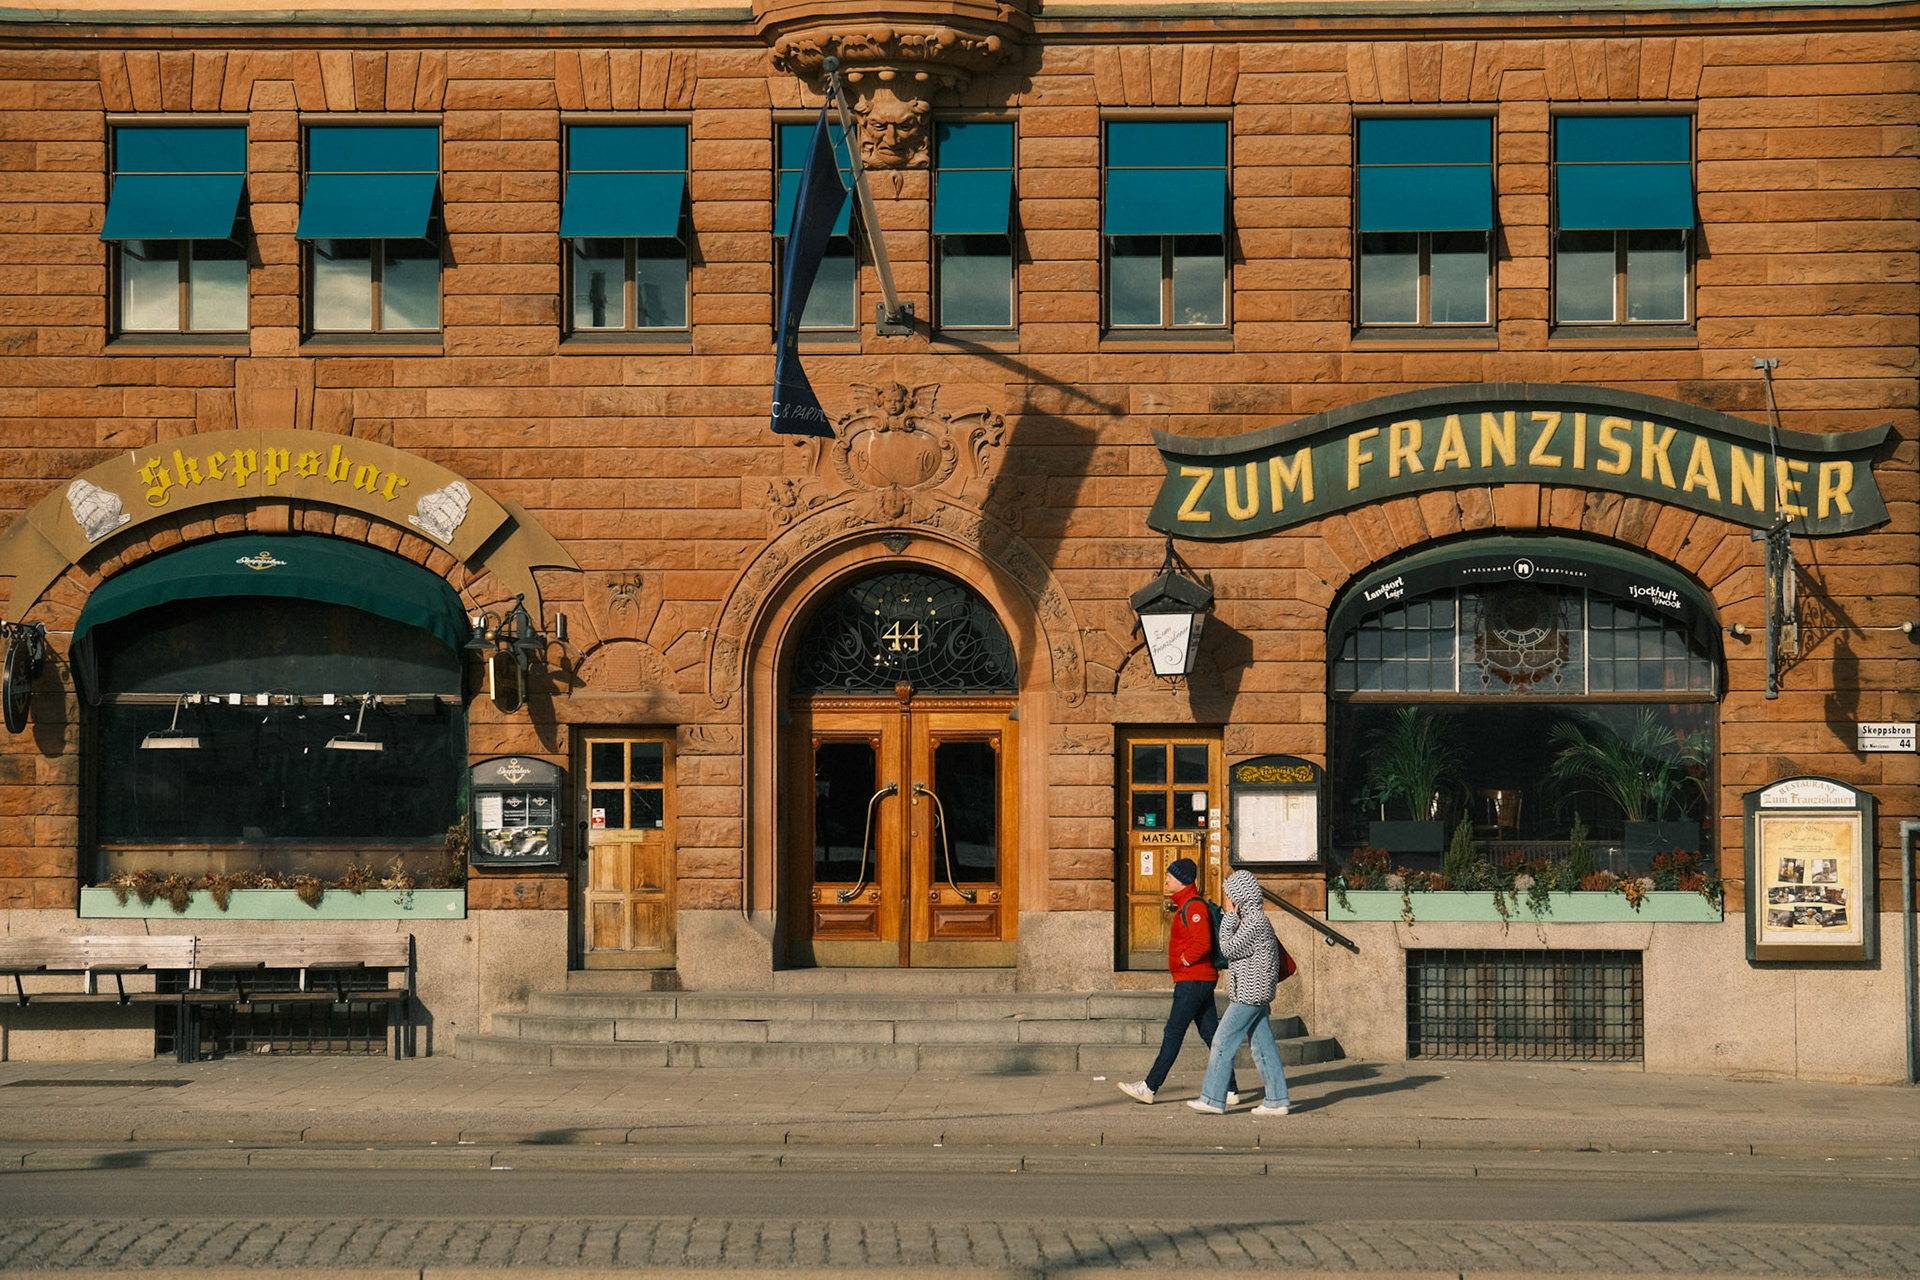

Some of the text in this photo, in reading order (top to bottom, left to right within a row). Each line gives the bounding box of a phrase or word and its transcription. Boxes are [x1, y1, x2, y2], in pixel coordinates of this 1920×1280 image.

[1177, 410, 1854, 522] ZUM FRANZISKANER
[137, 444, 410, 507] Skeppsbar
[236, 556, 287, 566] Skeppsbar
[1364, 576, 1404, 601] Landsort
[1384, 588, 1404, 600] Lager
[1629, 585, 1678, 600] Tjockhult
[882, 620, 923, 651] 44
[1862, 725, 1911, 736] Skeppsbron
[1899, 739, 1911, 748] 44
[1778, 780, 1837, 795] RESTAURANT
[1763, 792, 1855, 804] Zum Franziskaner
[1142, 833, 1186, 843] MATSAL
